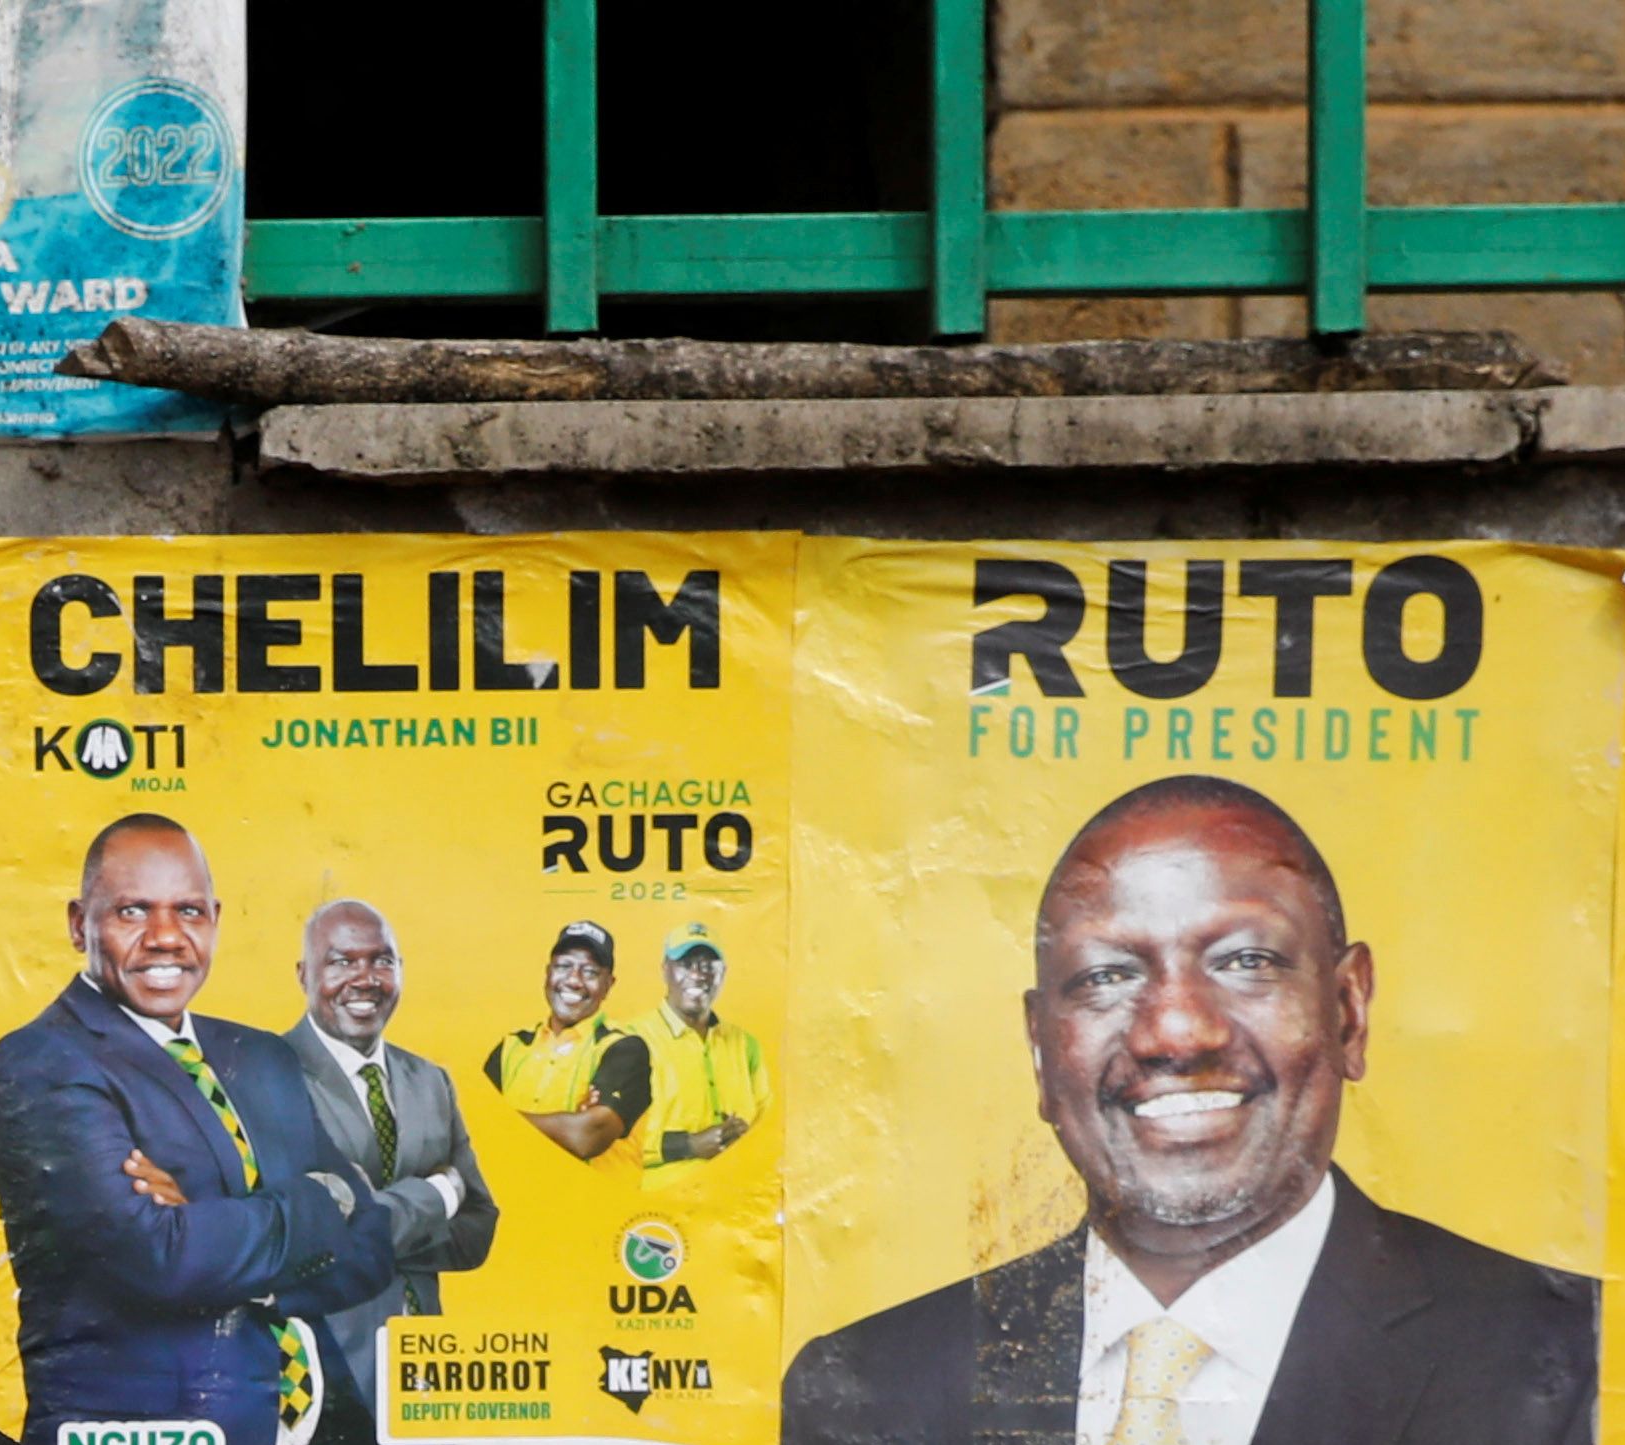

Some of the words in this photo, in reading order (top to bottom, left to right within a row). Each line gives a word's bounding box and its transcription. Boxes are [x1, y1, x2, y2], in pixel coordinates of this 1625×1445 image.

[99, 124, 217, 188] 2022
[1, 278, 147, 312] WARD
[29, 570, 720, 697] CHELILIM
[970, 554, 1484, 701] RUTO
[262, 720, 476, 749] JONATHAN
[491, 718, 539, 746] BII
[970, 705, 1079, 759] FOR
[1124, 707, 1482, 762] PRESIDENT
[131, 777, 187, 792] MOJA
[546, 780, 751, 808] GACHAGUA
[542, 814, 751, 873] RUTO
[611, 883, 686, 901] 2022
[609, 1285, 697, 1314] UDA
[616, 1319, 645, 1330] KAZI
[665, 1319, 693, 1329] KAZI
[400, 1335, 466, 1355] ENG.
[475, 1333, 549, 1353] JOHN
[400, 1359, 551, 1392] BAROROT
[401, 1401, 460, 1421] DEPUTY
[466, 1401, 551, 1421] GOVERNOR
